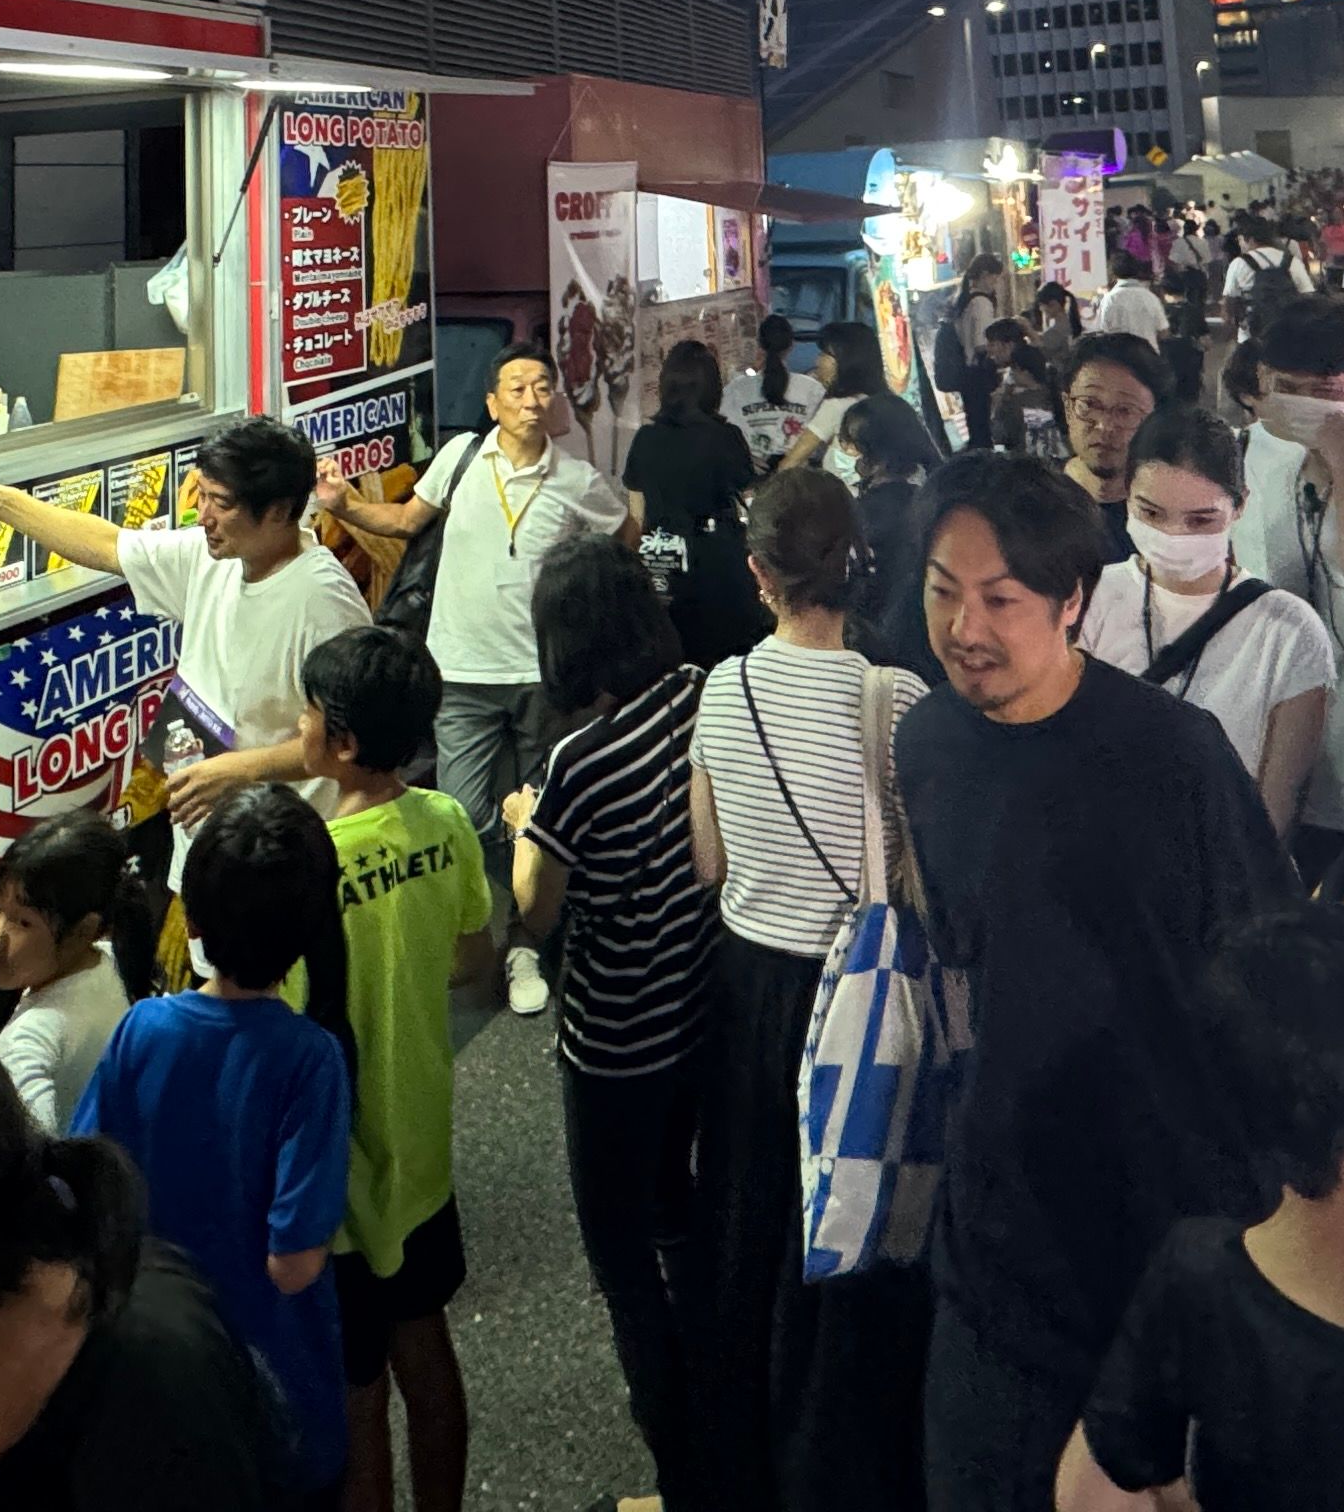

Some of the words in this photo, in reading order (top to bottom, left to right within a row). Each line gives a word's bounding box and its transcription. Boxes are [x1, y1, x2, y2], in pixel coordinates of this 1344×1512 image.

[284, 112, 344, 146] LONG
[347, 116, 424, 150] POTATO
[293, 328, 354, 355] チョコレート
[294, 392, 406, 446] AMERICAN
[13, 704, 132, 811] LONG
[341, 837, 454, 913] ATHLETA
